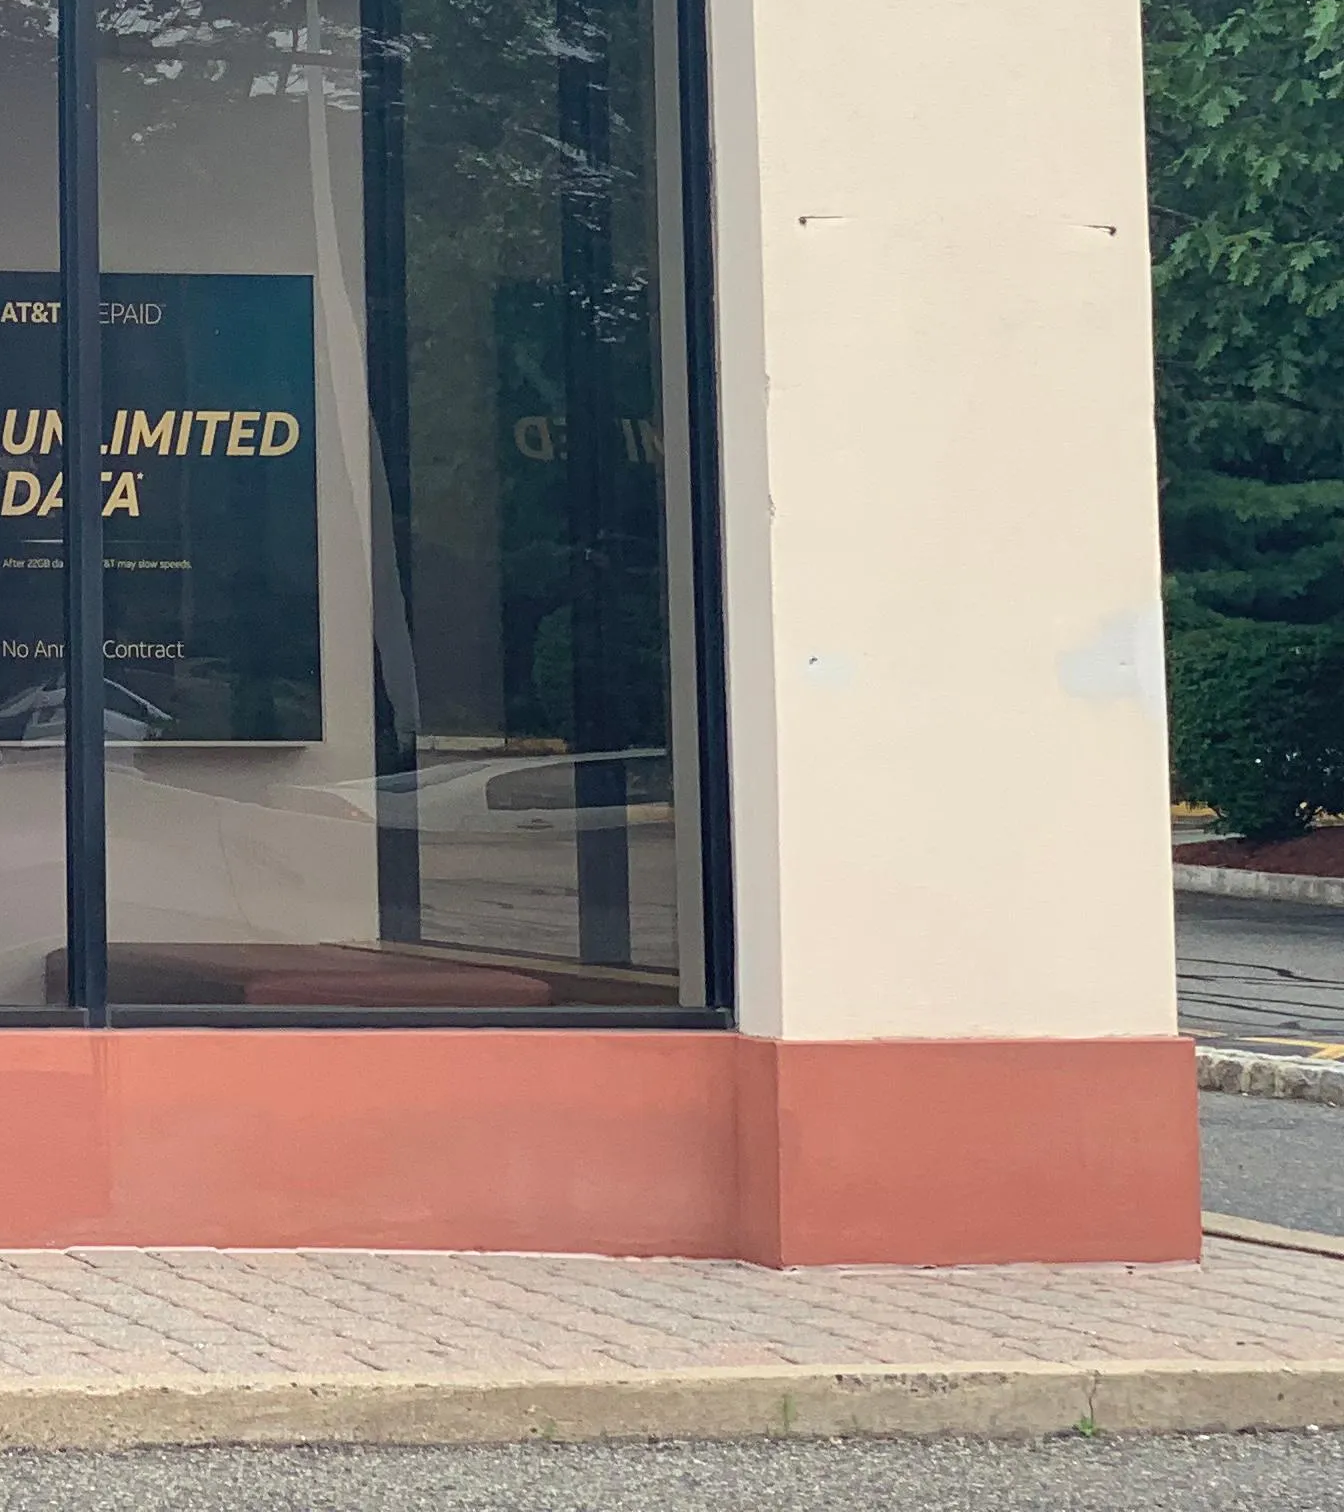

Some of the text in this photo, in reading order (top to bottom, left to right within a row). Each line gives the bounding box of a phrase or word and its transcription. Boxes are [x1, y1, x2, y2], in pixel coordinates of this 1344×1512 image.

[0, 302, 61, 324] AT&T
[2, 409, 300, 456] UNIMITED
[2, 558, 24, 568] After
[118, 559, 136, 571] may
[138, 558, 157, 569] slow
[2, 640, 29, 658] No
[102, 640, 185, 659] Contract
